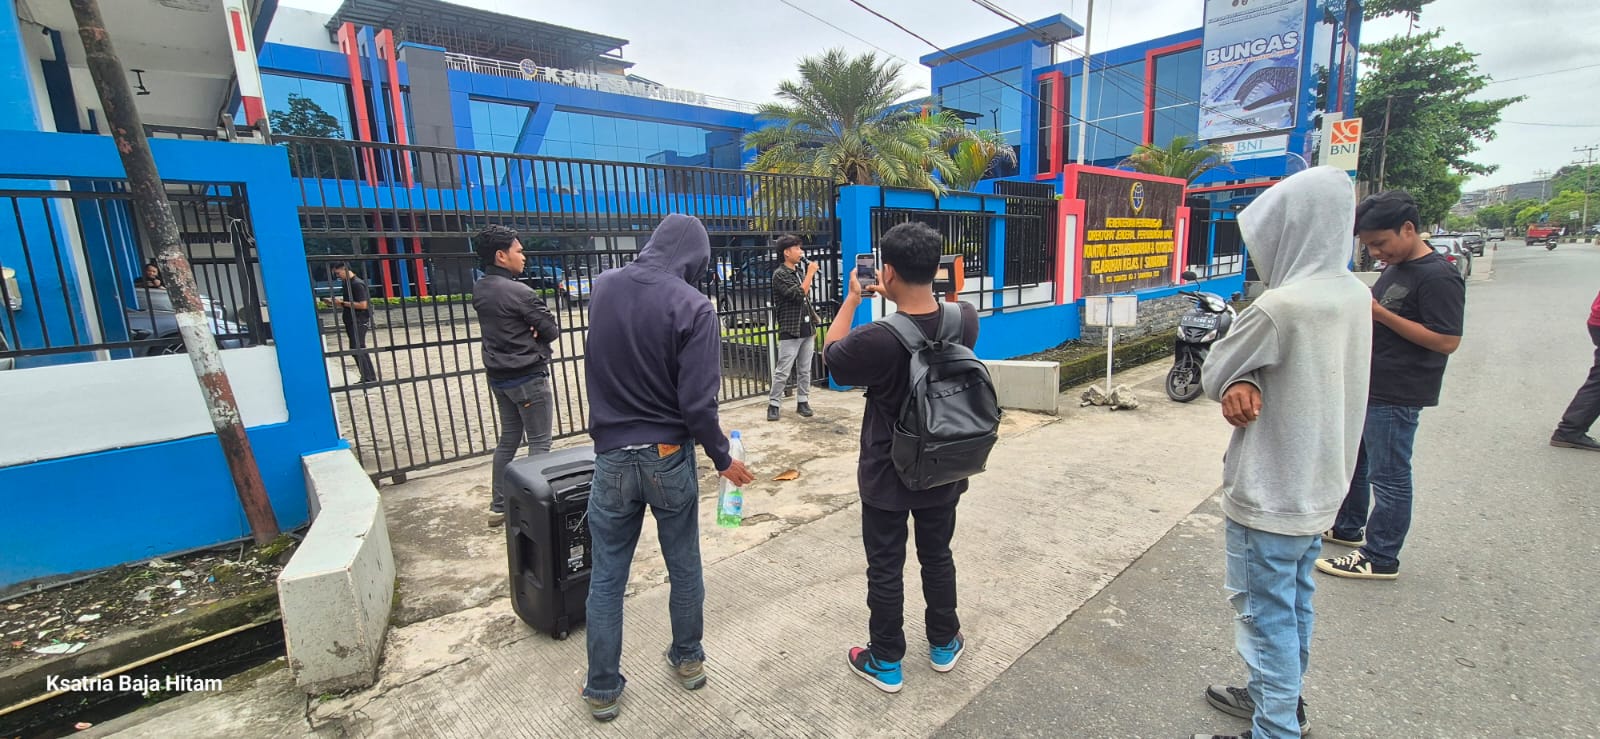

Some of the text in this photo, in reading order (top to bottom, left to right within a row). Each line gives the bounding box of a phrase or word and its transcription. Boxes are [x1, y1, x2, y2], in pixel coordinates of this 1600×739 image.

[1205, 31, 1298, 67] BUNGAS
[1237, 139, 1263, 152] BNI
[1330, 144, 1356, 155] BNI
